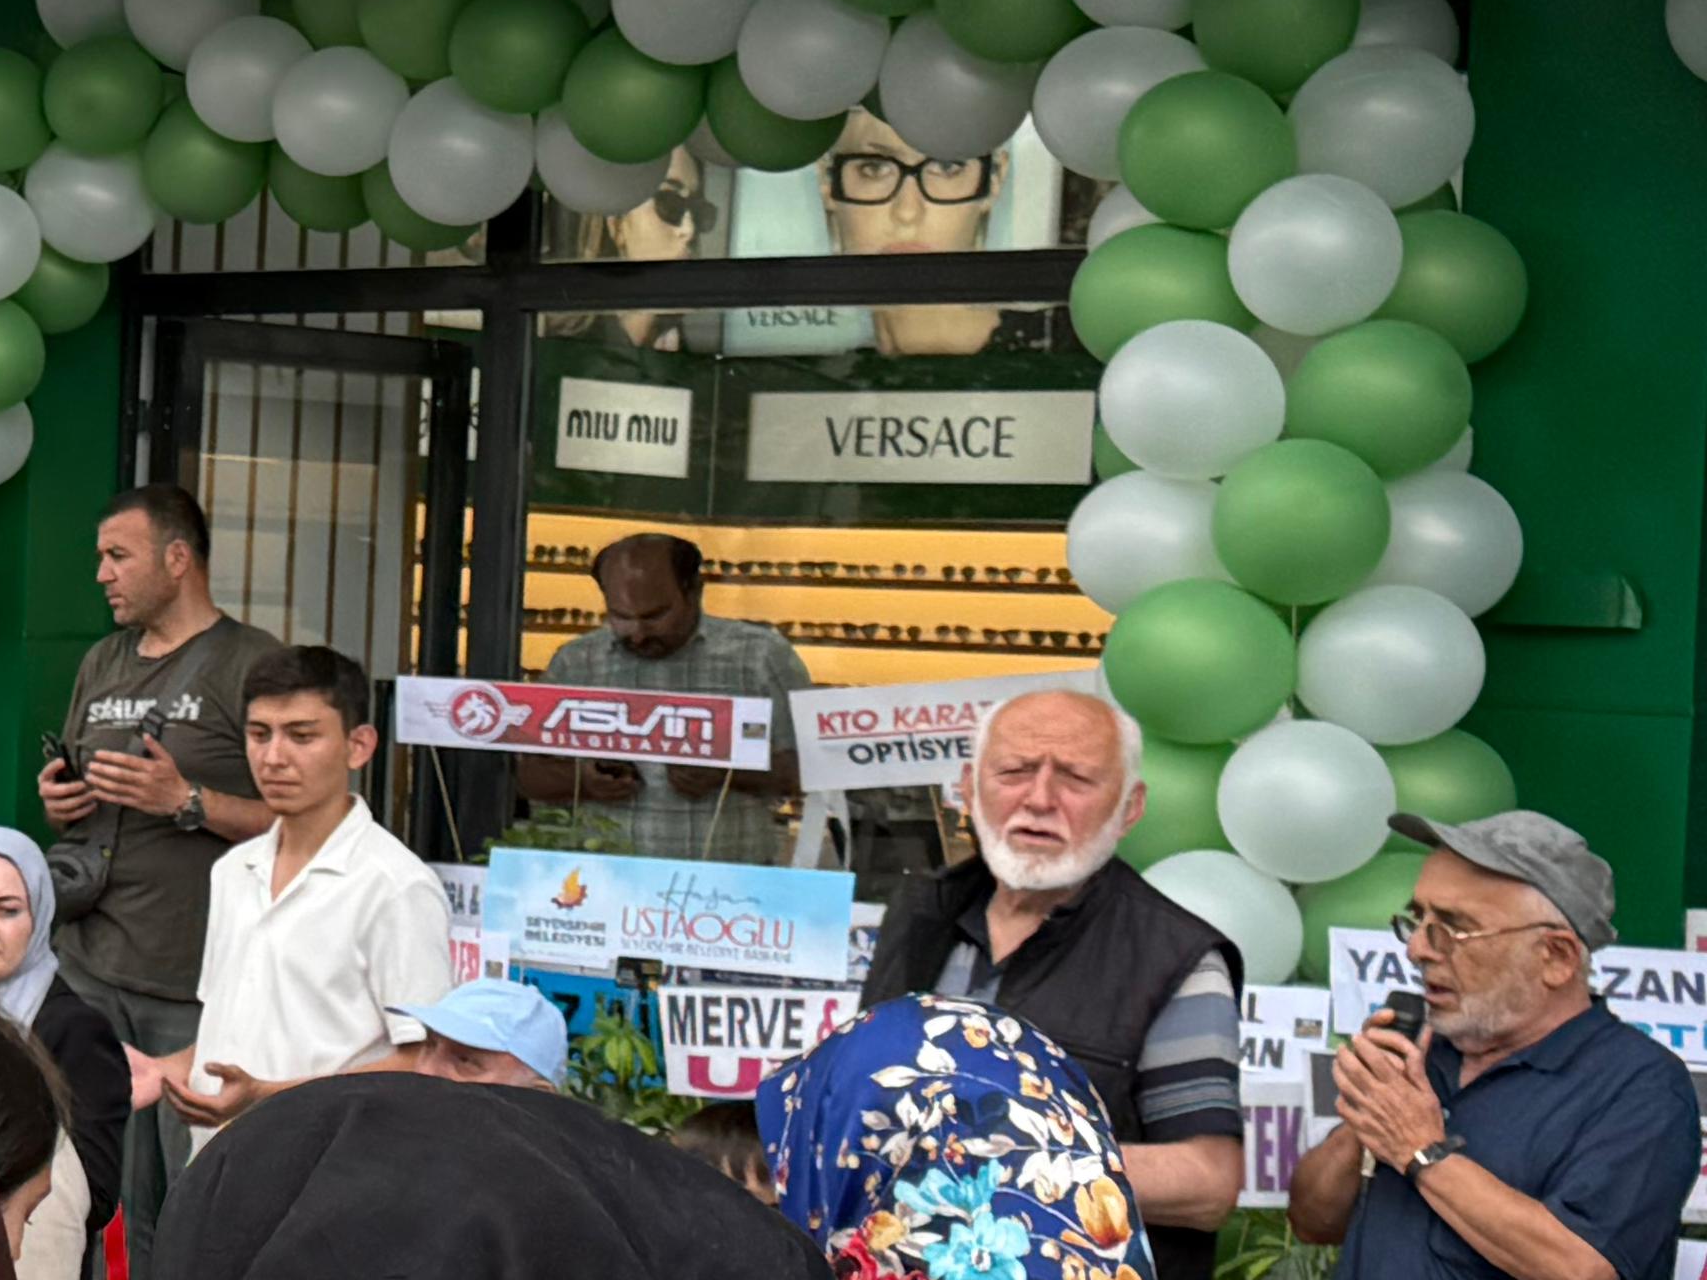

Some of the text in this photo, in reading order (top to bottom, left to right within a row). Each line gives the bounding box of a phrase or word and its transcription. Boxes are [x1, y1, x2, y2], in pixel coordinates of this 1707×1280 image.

[825, 416, 1017, 459] VERSACE
[816, 709, 879, 735] KTO
[848, 733, 973, 765] OPTİSYE
[667, 995, 805, 1049] MERVE
